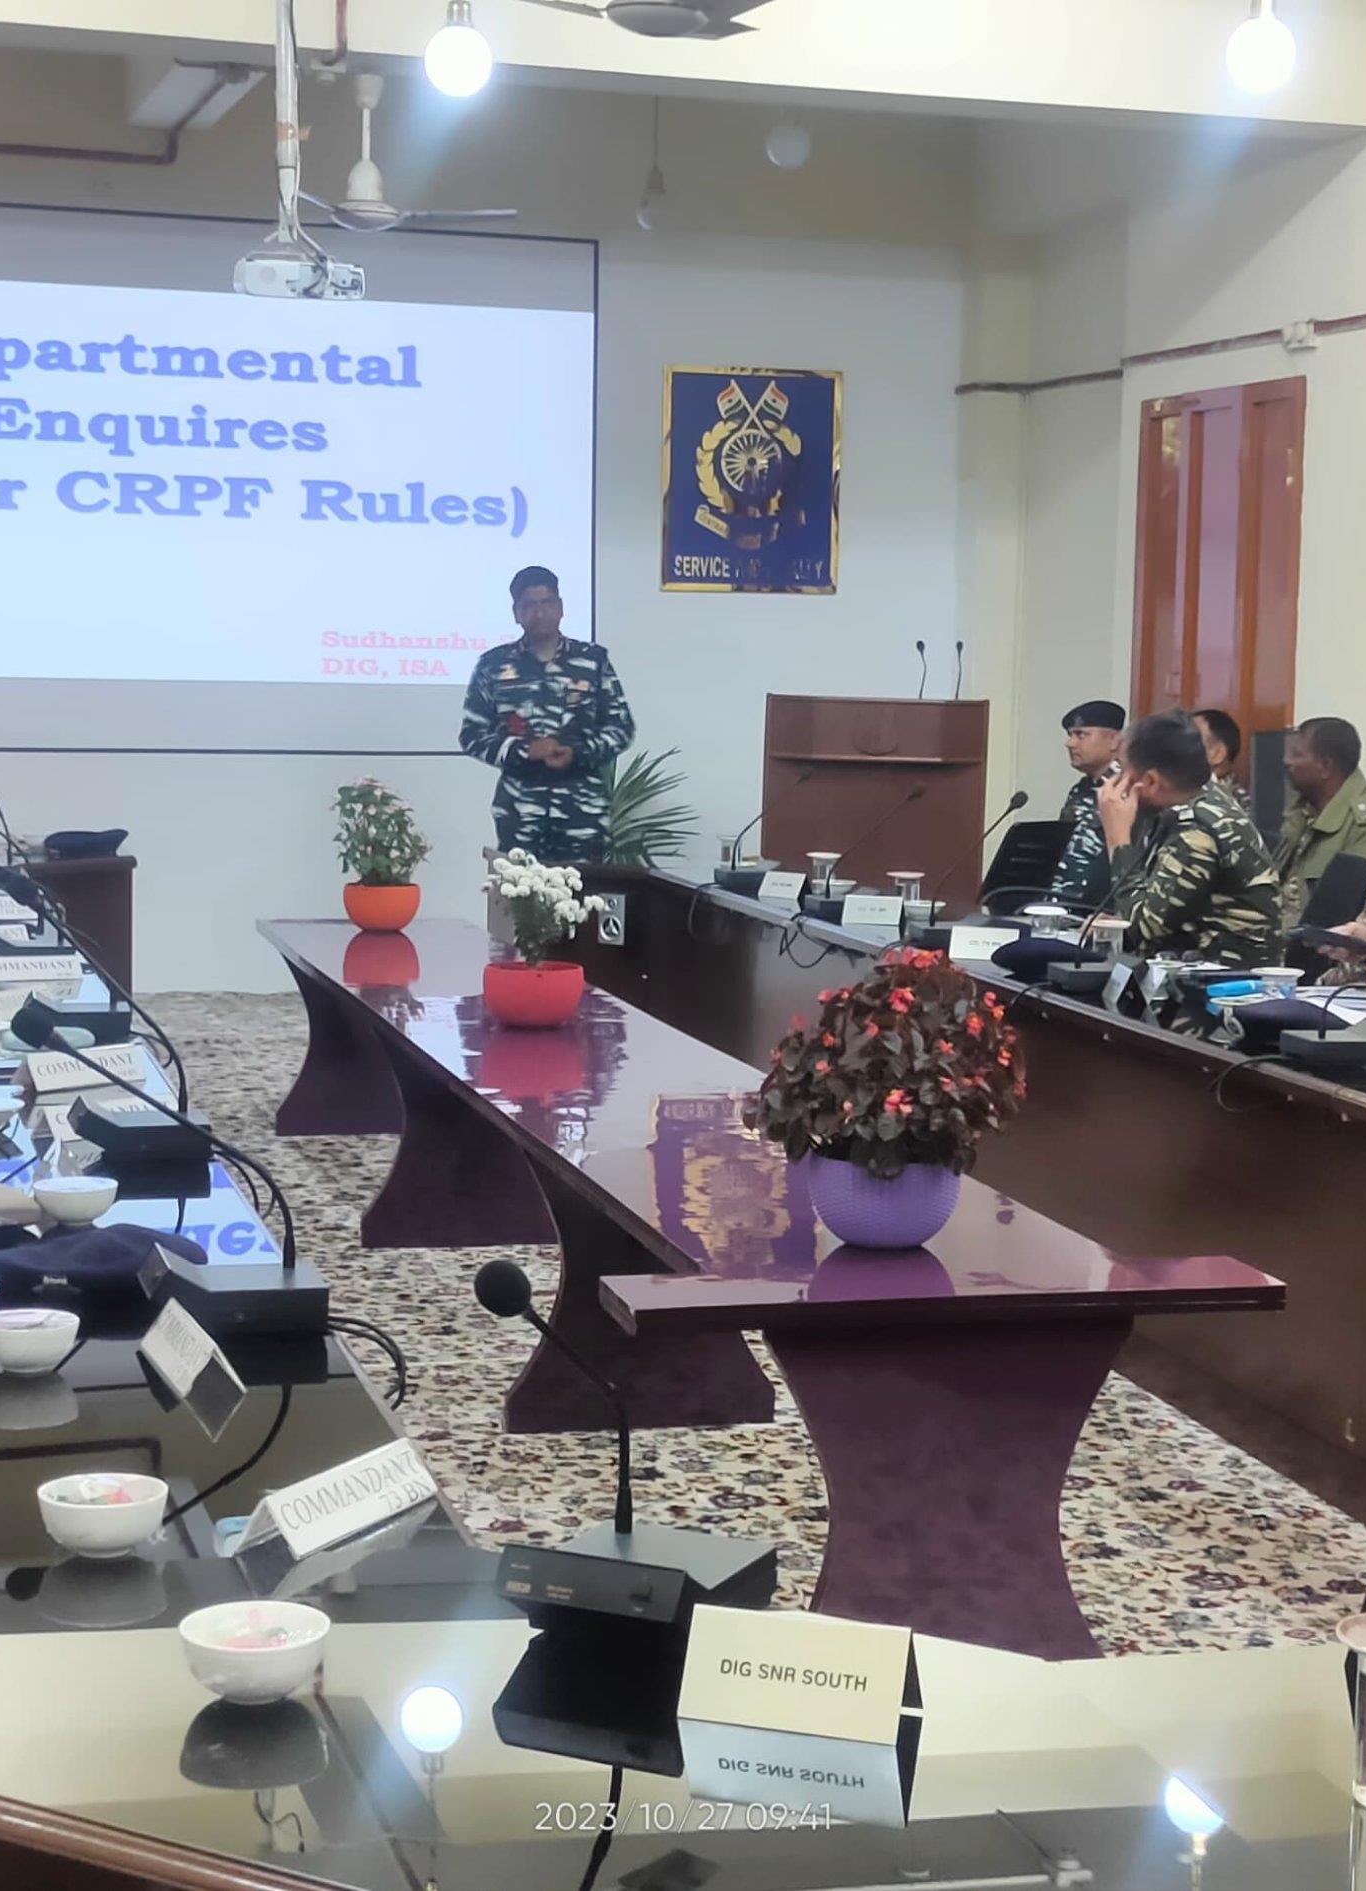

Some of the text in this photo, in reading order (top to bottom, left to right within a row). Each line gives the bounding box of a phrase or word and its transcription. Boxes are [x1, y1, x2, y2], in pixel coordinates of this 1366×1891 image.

[55, 471, 273, 519] CRPF
[300, 480, 529, 538] Rules)
[674, 555, 730, 578] SERVICE
[322, 630, 487, 651] Sudhanshu
[321, 657, 450, 678] DIG, ISA
[279, 1449, 420, 1531] COMMANDANT
[406, 1473, 432, 1503] BN
[720, 1658, 868, 1692] DIG SNR SOUTH
